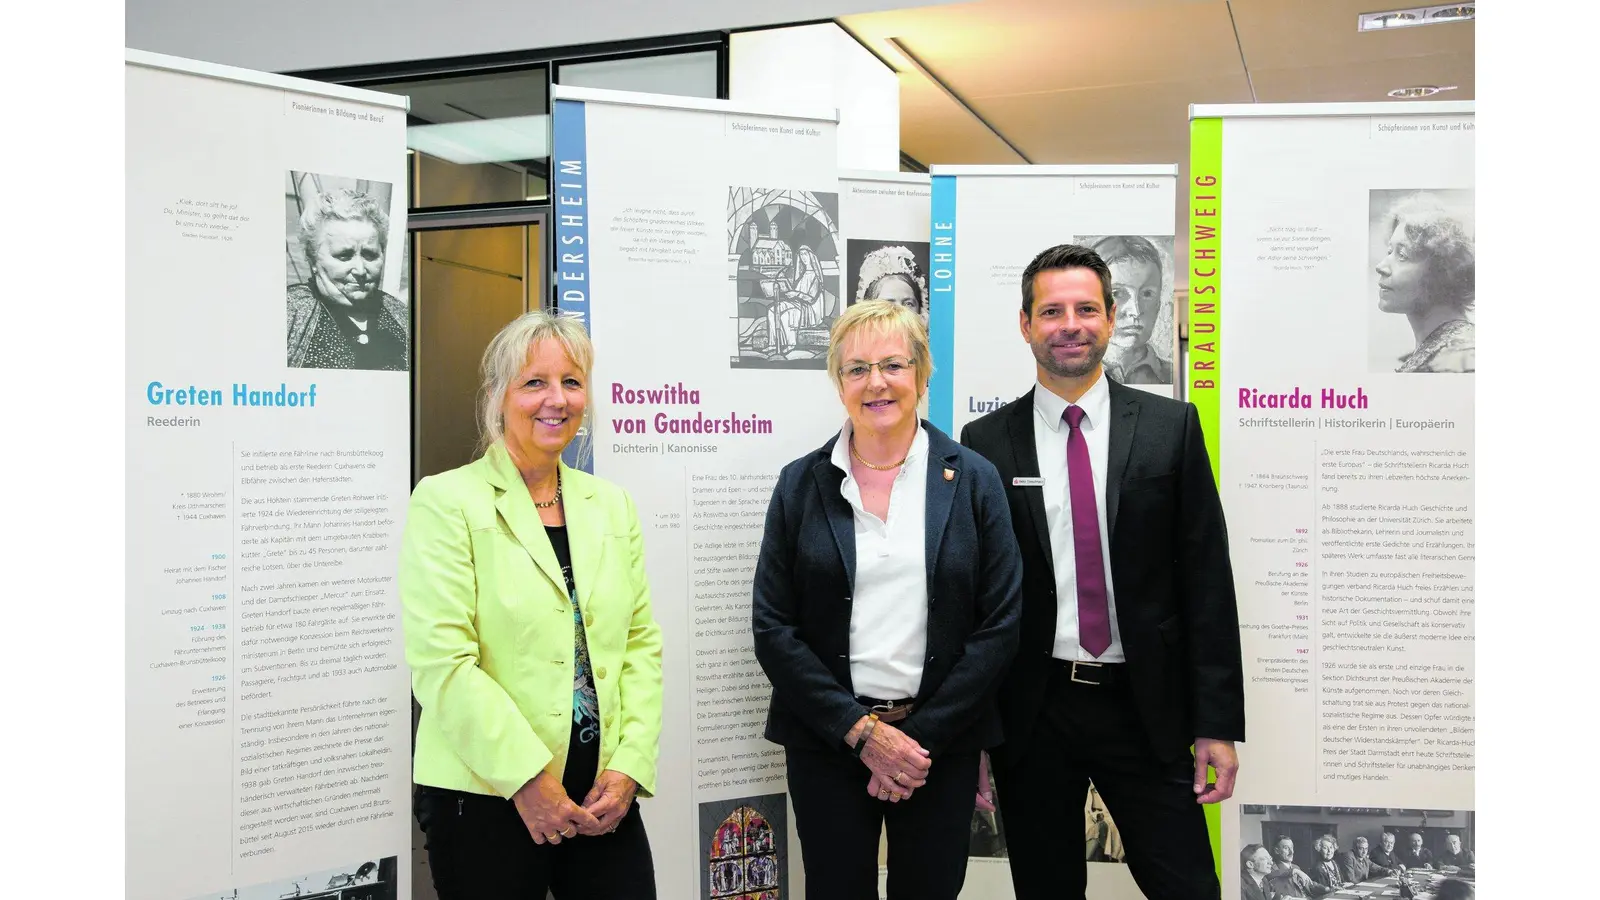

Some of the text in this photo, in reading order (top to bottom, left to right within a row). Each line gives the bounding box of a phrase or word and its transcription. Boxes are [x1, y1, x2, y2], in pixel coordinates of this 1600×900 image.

[292, 102, 328, 114] Pionierinnen
[336, 108, 356, 120] Bildung
[370, 114, 384, 123] Beruf
[732, 122, 768, 132] Schöpferinnen
[780, 126, 794, 134] Kunst
[1378, 123, 1418, 133] Schöpferinnen
[560, 160, 586, 322] NDERSHEIM
[934, 222, 952, 292] LOHNE
[1194, 175, 1216, 389] BRAUNSCHWEIG
[147, 381, 316, 407] Greten Handorf
[612, 382, 700, 404] Roswitha
[1239, 387, 1368, 409] Ricarda Huch
[147, 416, 200, 427] Reederin
[612, 411, 772, 433] von Gandersheim
[1239, 417, 1455, 430] Schriftstellerin Historikerin Europäerin
[613, 443, 718, 453] Dichterin Kanonisse
[1322, 503, 1468, 513] Ab 1888 studierte Ricarda Huch Geschichte und
[1322, 515, 1356, 526] Philosophie
[1367, 516, 1377, 524] der
[1379, 516, 1412, 524] Universität
[1435, 516, 1444, 525] Sie
[1446, 517, 1473, 525] arbeitete
[1322, 662, 1465, 673] 1926 wurde sie als erste und einzige Frau in die
[1322, 674, 1474, 685] Sektion Dichtkunst der Preußischen Akademie der
[1323, 772, 1336, 781] und
[1337, 773, 1362, 783] mutiges
[240, 810, 395, 845] büttel seit August 2015 wieder durch eine Fährlinie
